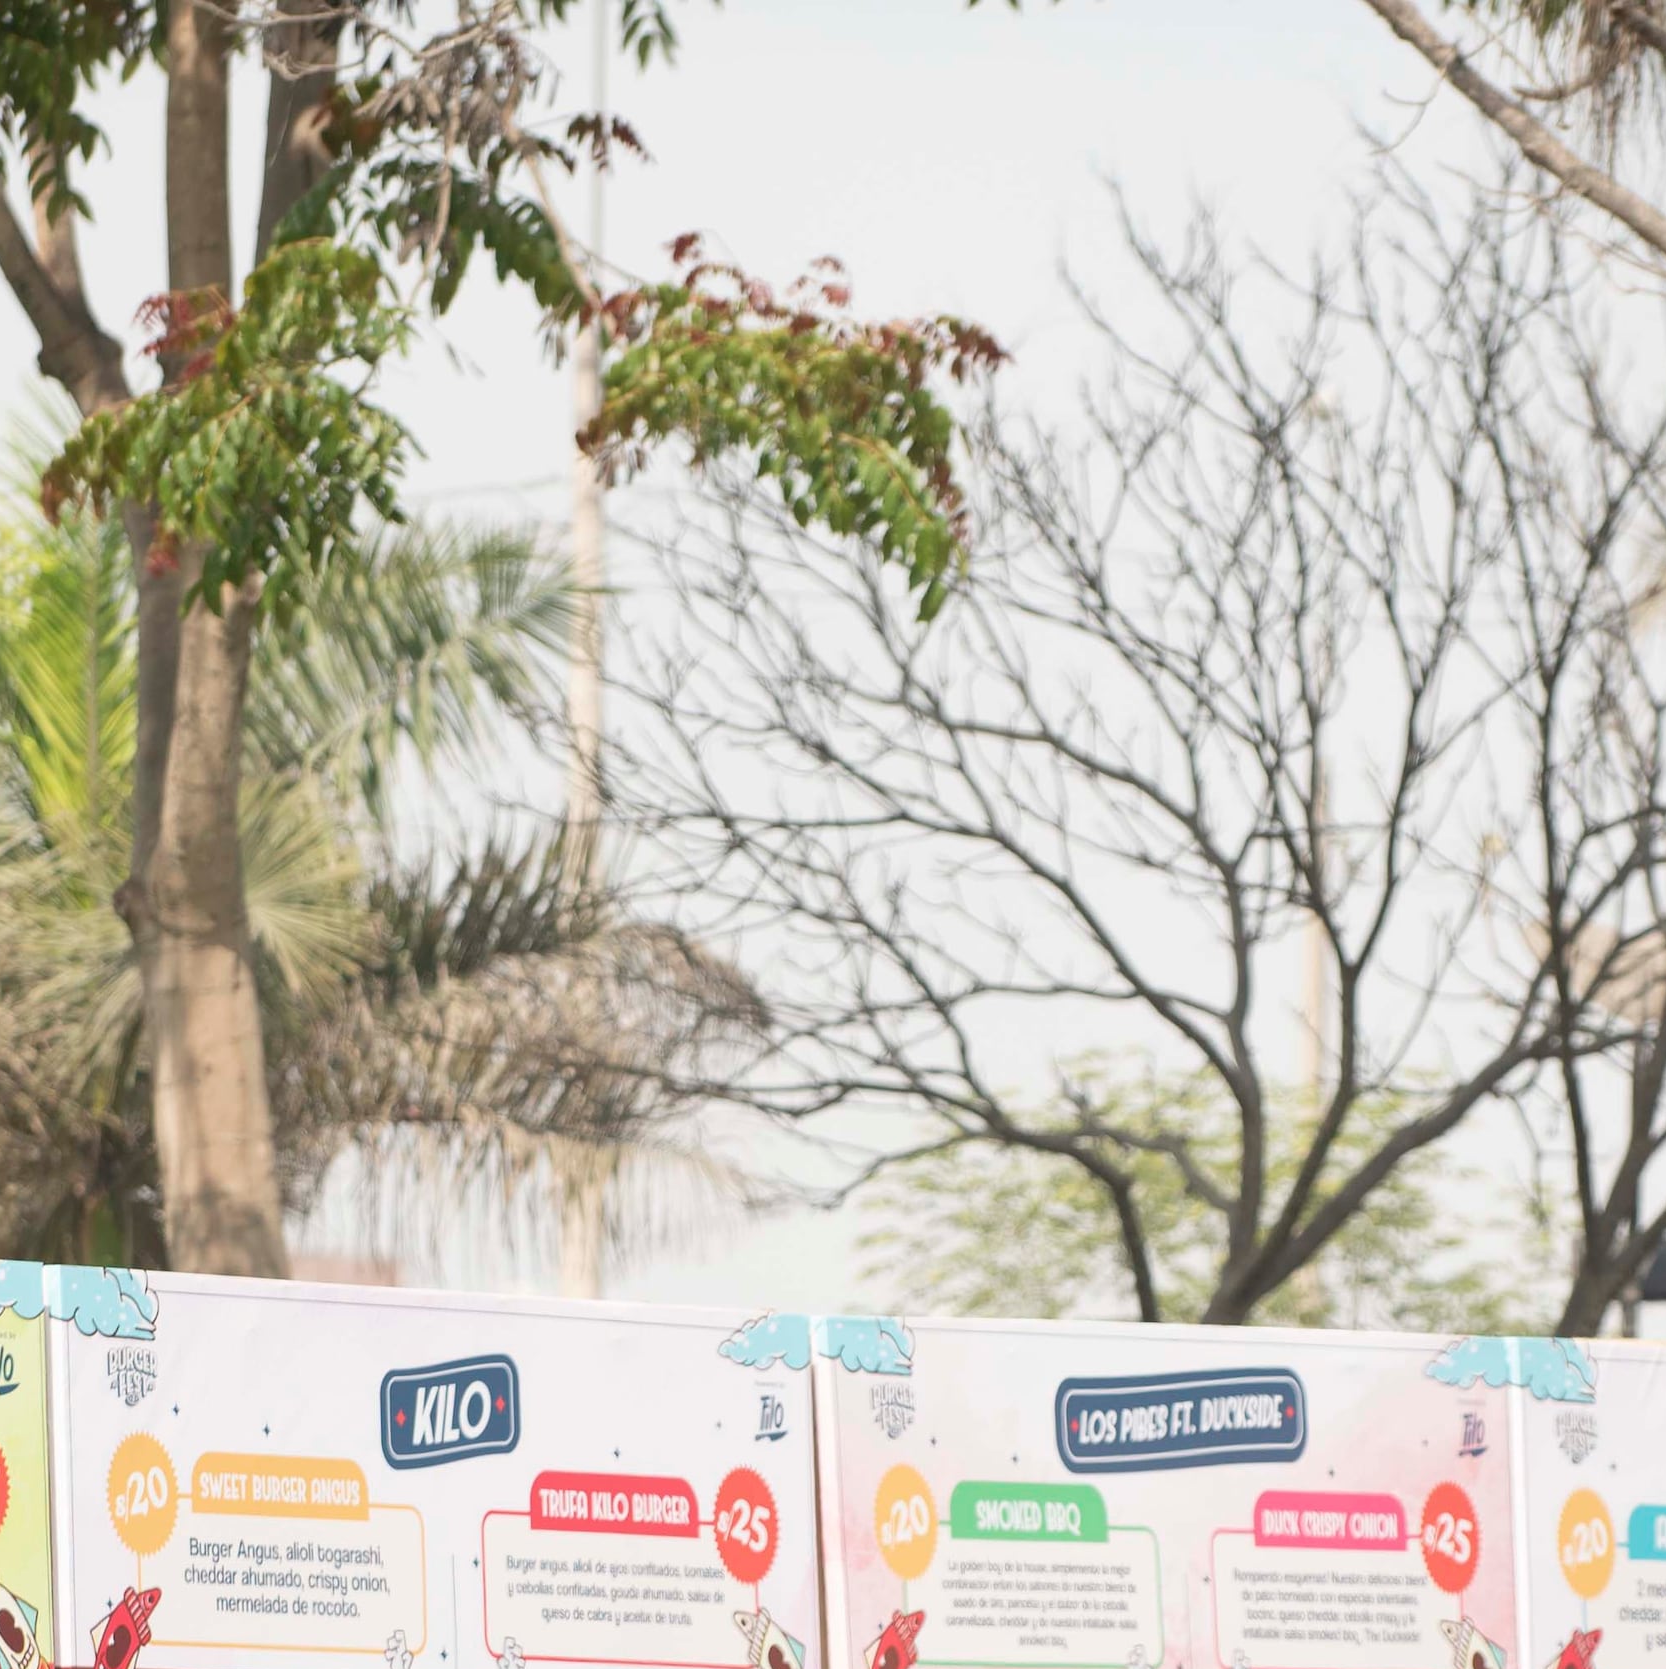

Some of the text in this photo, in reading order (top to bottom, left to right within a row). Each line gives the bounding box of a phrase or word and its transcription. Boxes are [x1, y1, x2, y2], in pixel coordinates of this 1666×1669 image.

[107, 1347, 158, 1379] BURGER
[411, 1380, 492, 1447] KILO
[1078, 1393, 1284, 1446] LOS PIBES FT. DUCKSIDE
[200, 1471, 360, 1507] SWEET BURGER ANGUS
[539, 1488, 690, 1526] TRUFA KILO BURGER
[975, 1500, 1082, 1537] SMOKED BBQ
[1261, 1508, 1299, 1538] DUCK
[189, 1538, 383, 1569] Burger Angus, alioli togarashi,
[184, 1565, 390, 1594] cheddar ahumado, crispy onion,
[216, 1593, 360, 1616] mermelada de rocoto.
